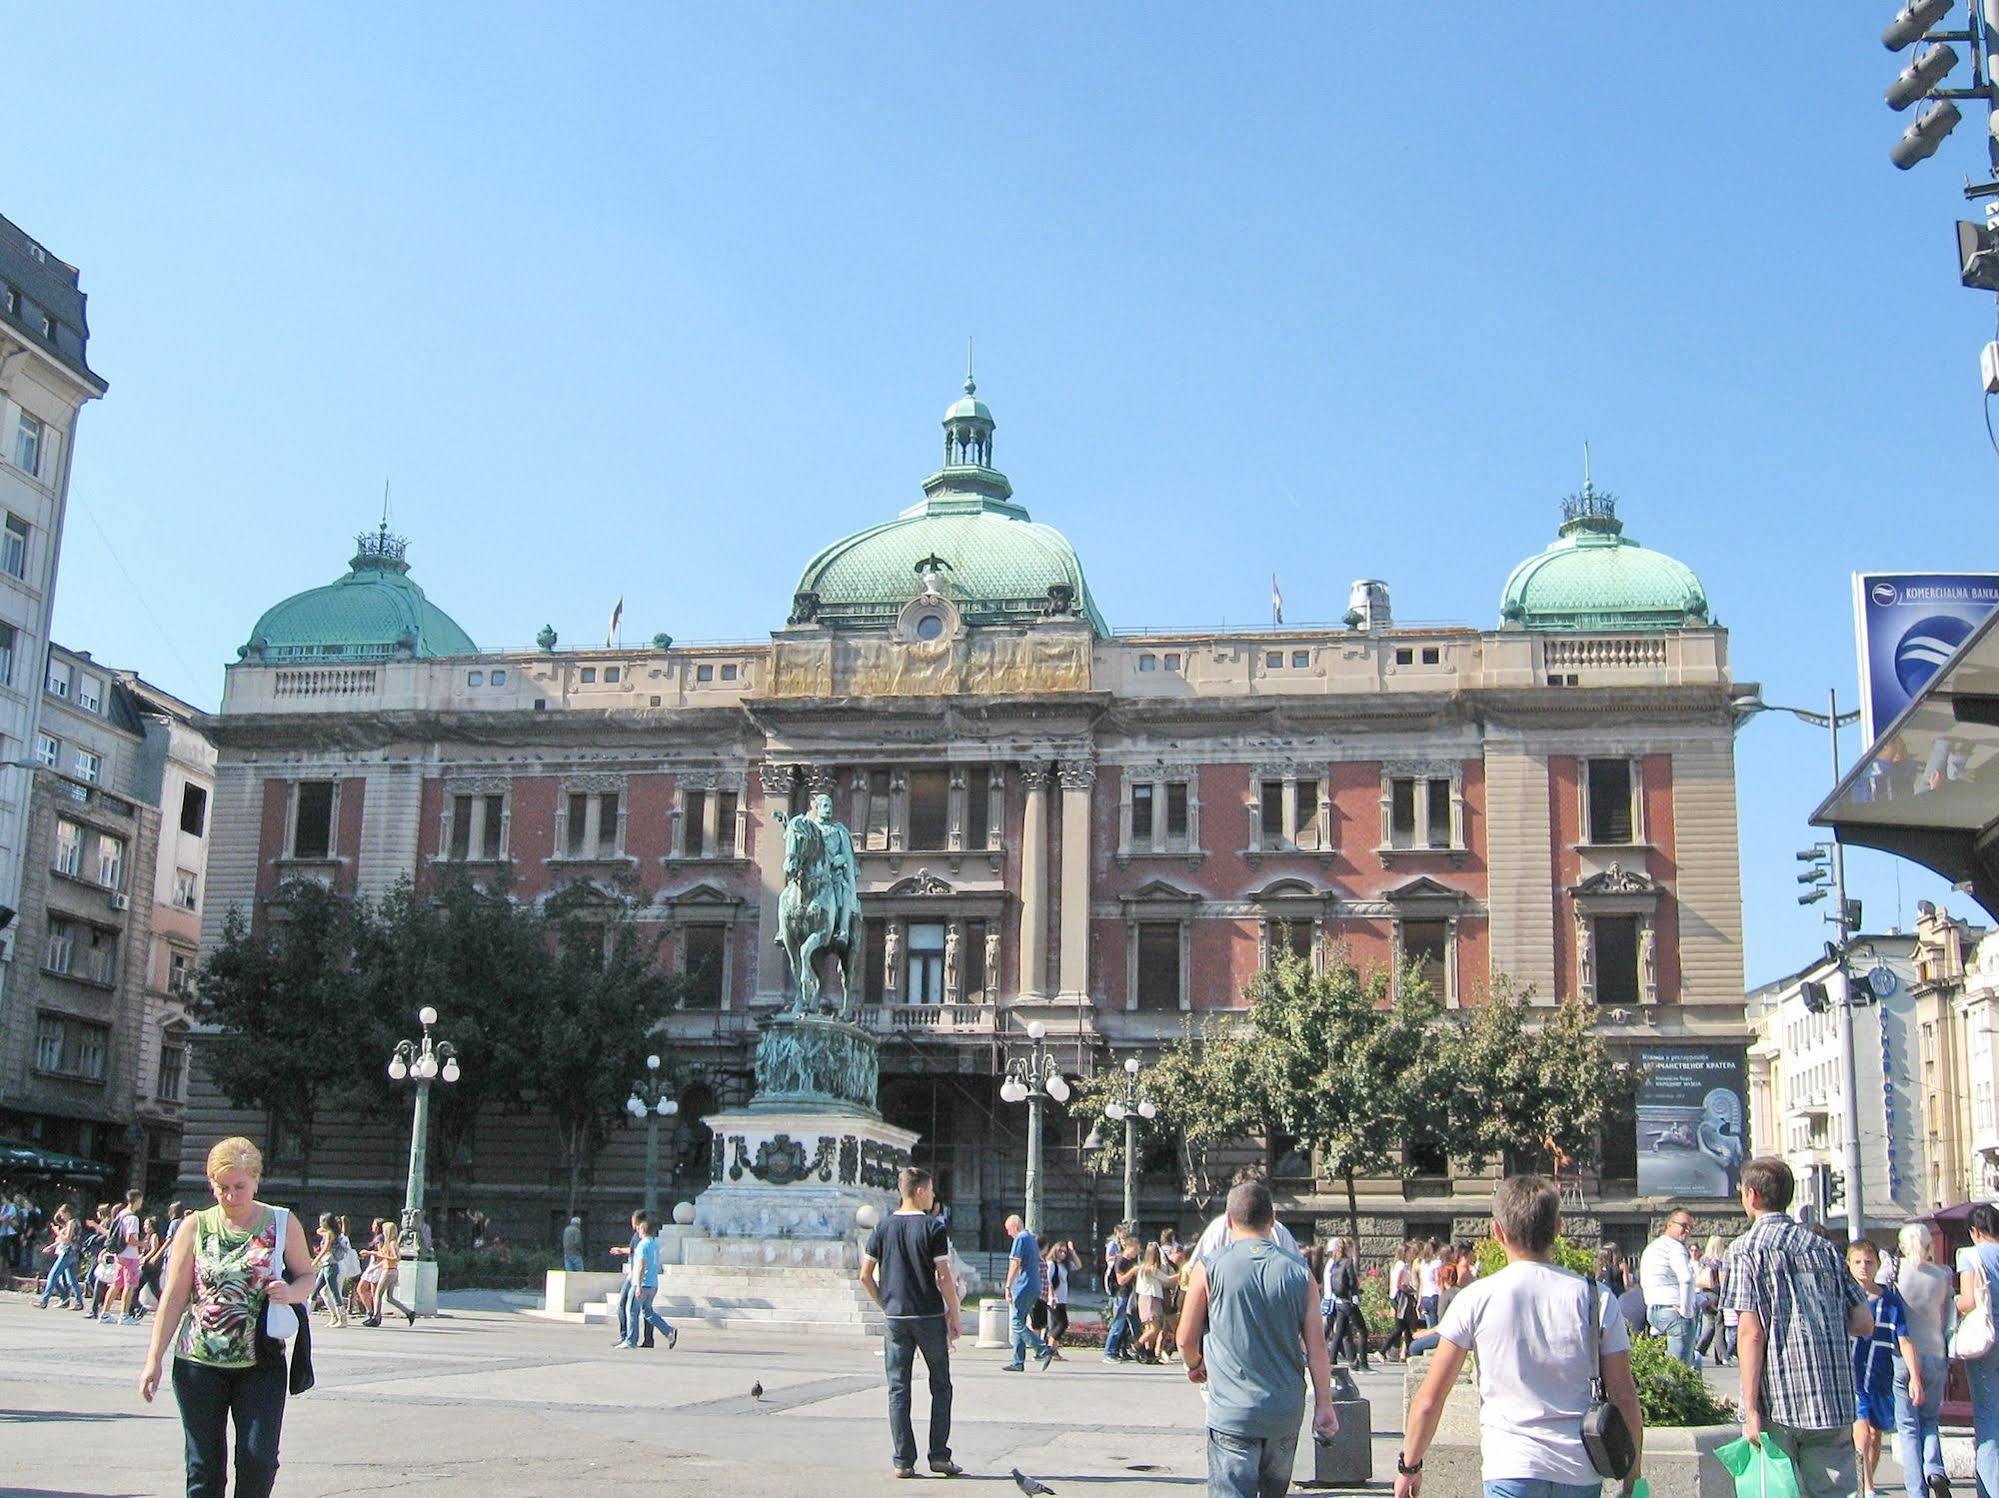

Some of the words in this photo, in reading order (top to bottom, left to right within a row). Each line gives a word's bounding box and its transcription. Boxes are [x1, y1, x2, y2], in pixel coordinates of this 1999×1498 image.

[1905, 587, 1968, 600] KOMERCIJALNA
[1971, 588, 1999, 600] BANKA
[1705, 1062, 1737, 1070] КРАТЕРА
